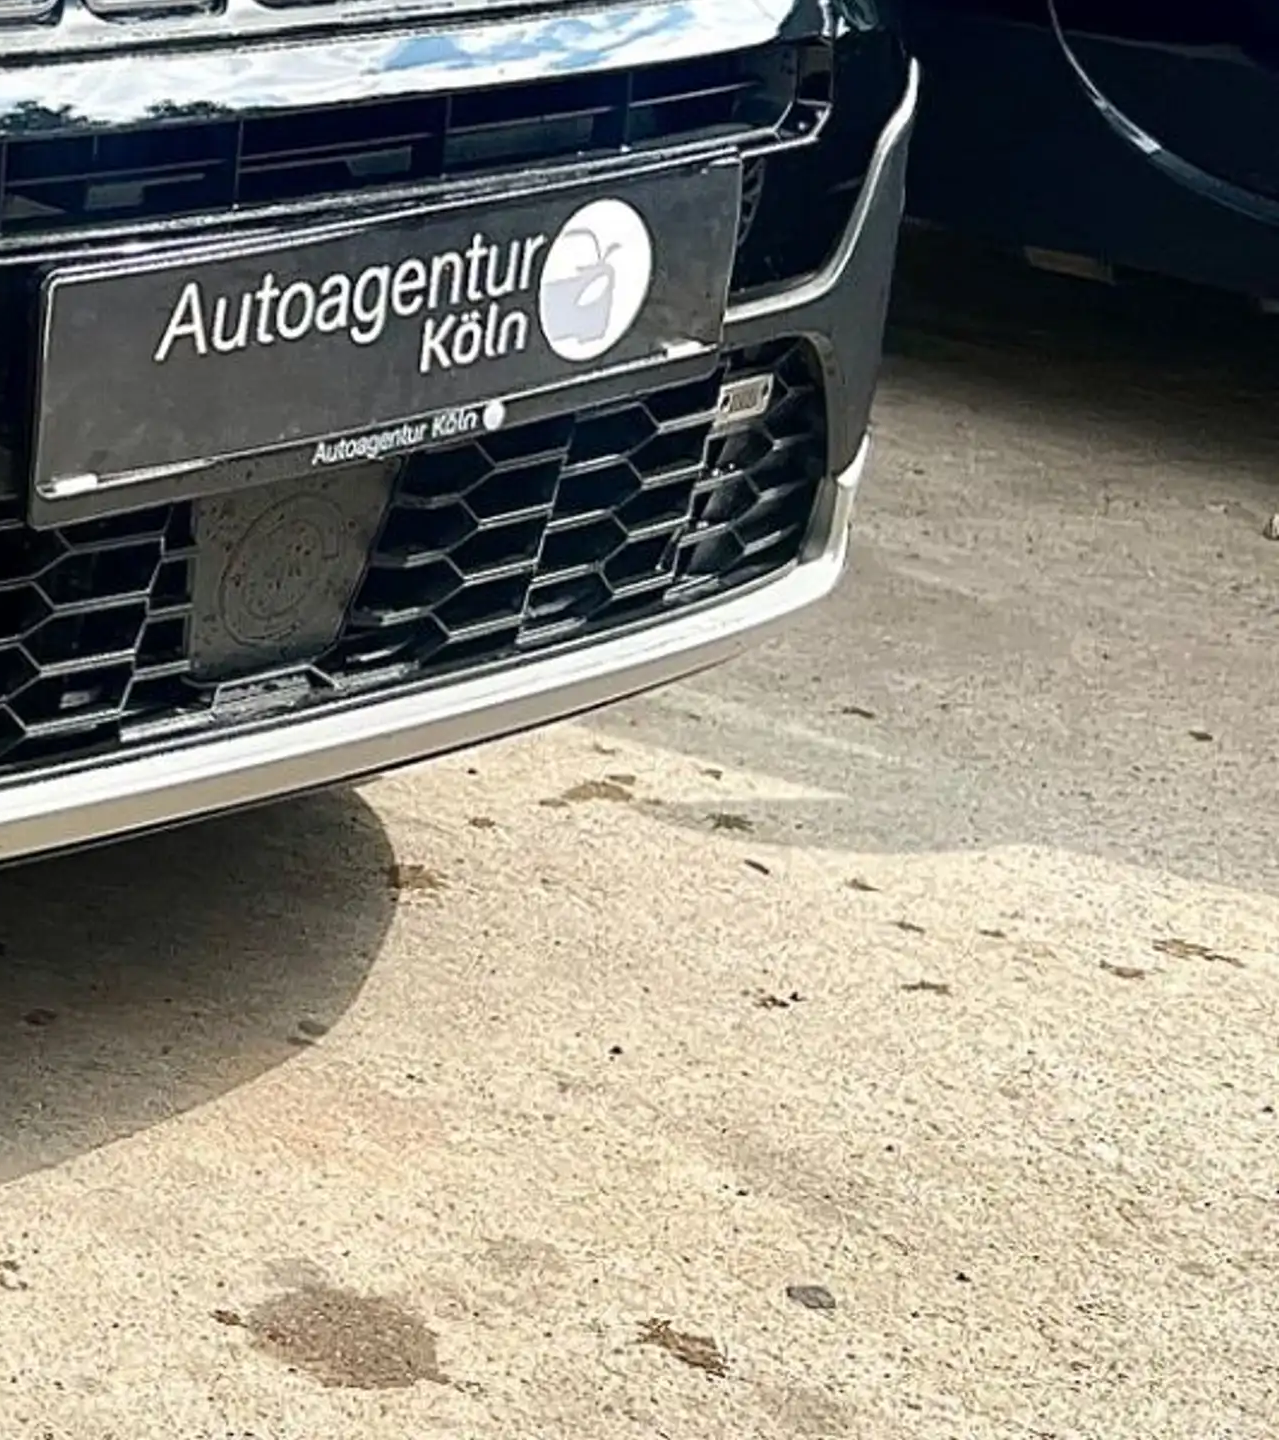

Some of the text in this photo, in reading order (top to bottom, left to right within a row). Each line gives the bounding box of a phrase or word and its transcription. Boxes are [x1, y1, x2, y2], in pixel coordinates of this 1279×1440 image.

[153, 232, 546, 362] Autoagentur
[418, 302, 530, 374] Köln
[311, 407, 479, 466] Autoagentur Köln
